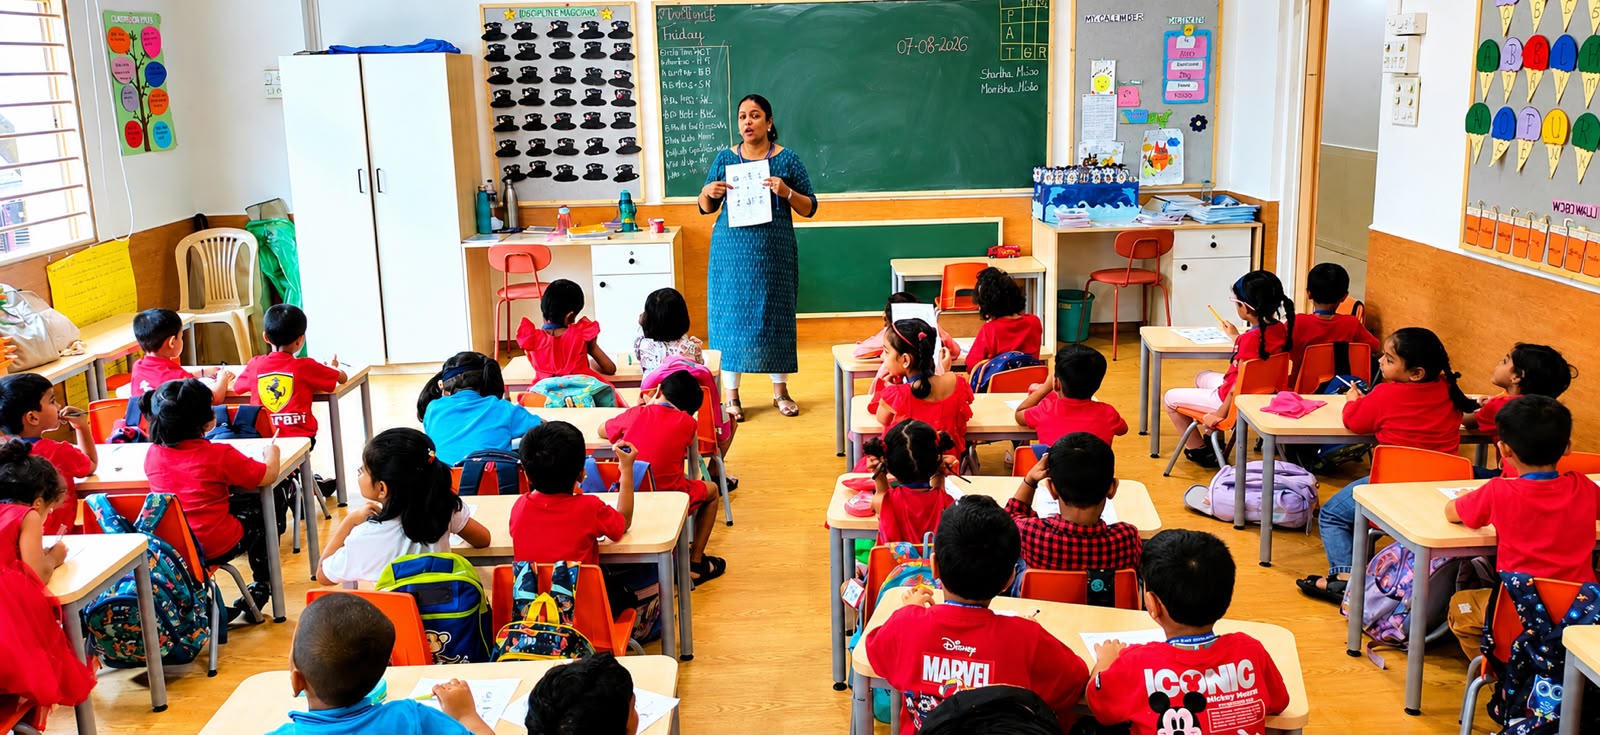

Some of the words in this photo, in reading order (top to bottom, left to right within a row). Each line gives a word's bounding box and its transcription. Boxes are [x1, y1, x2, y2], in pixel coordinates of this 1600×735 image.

[661, 22, 705, 47] Friday
[1005, 26, 1014, 39] A
[941, 637, 977, 657] Disney
[922, 654, 990, 687] MARVEL
[1143, 658, 1256, 698] ICONIC
